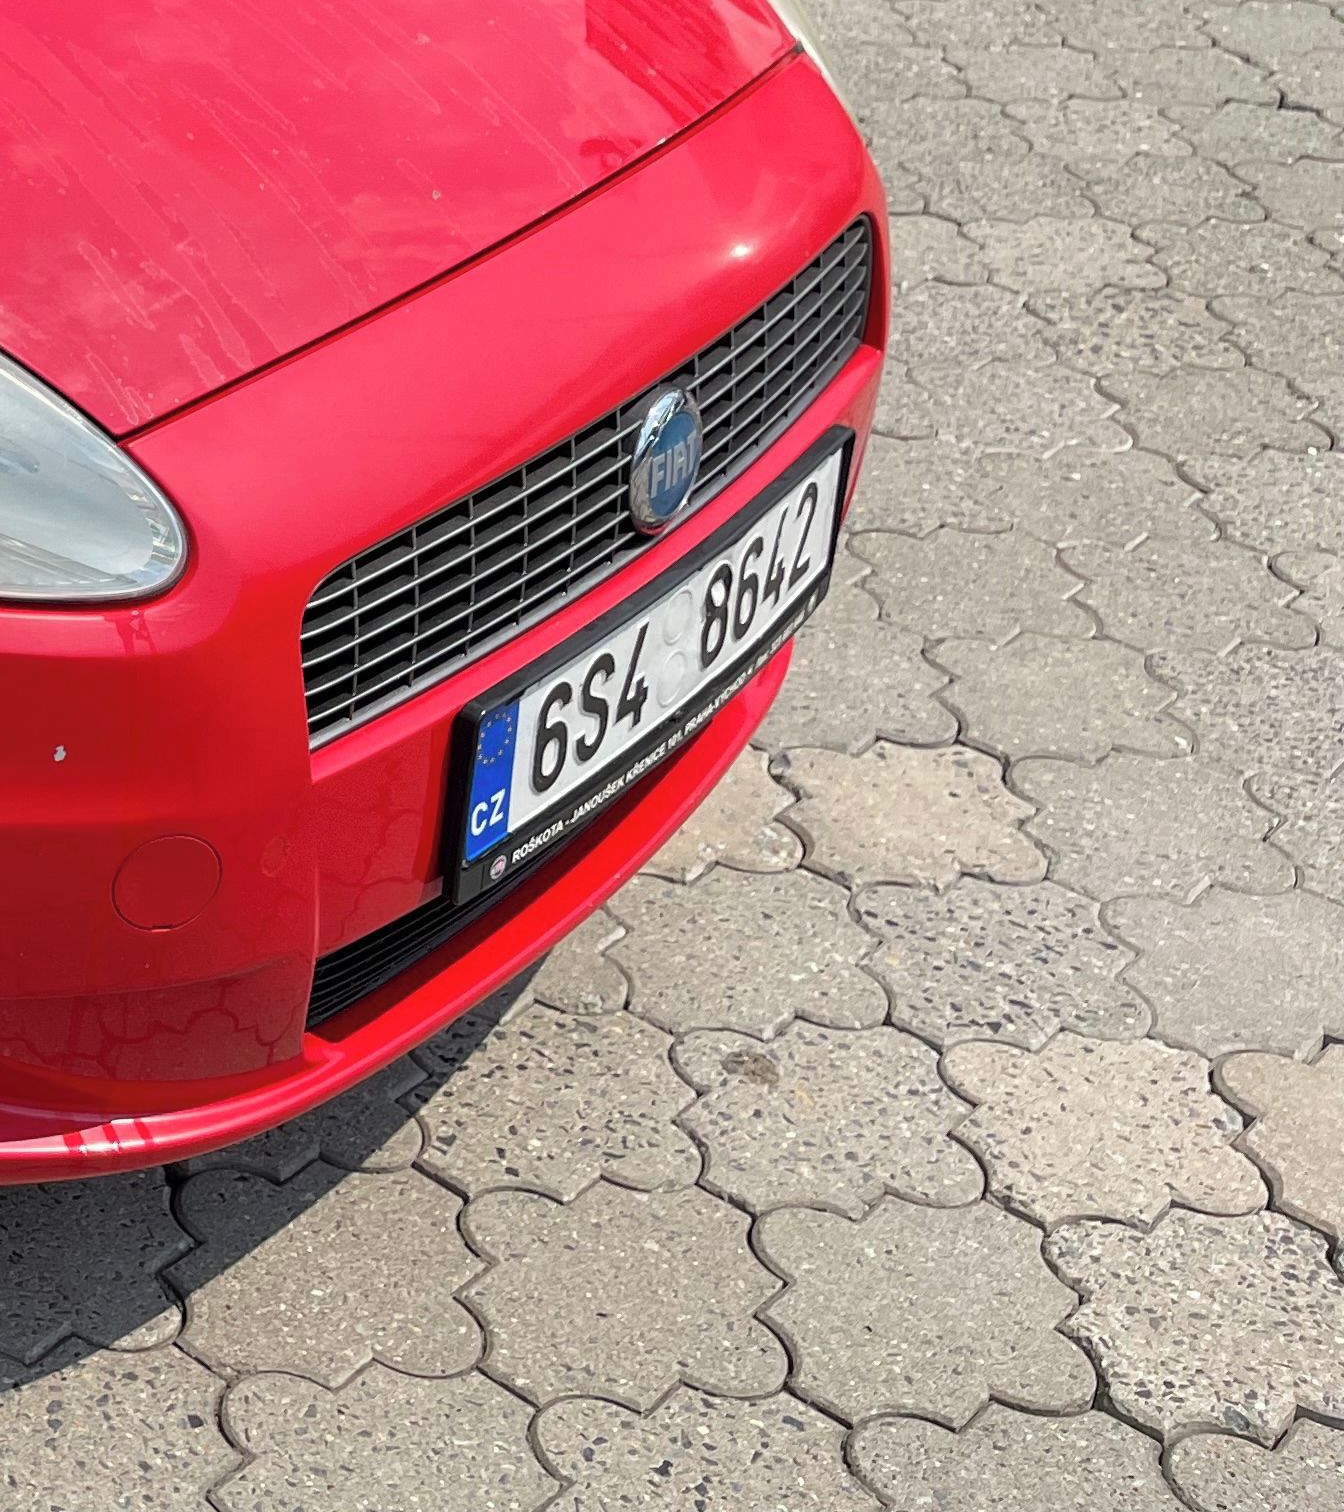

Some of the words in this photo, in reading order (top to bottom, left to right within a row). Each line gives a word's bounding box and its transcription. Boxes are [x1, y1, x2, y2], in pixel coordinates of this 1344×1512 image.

[650, 429, 697, 499] FIAT
[531, 622, 649, 793] 6S4
[699, 481, 819, 670] 8642
[471, 788, 506, 837] CZ
[512, 819, 564, 864] ROŠKOTA
[570, 777, 625, 824] JANOUŠEK
